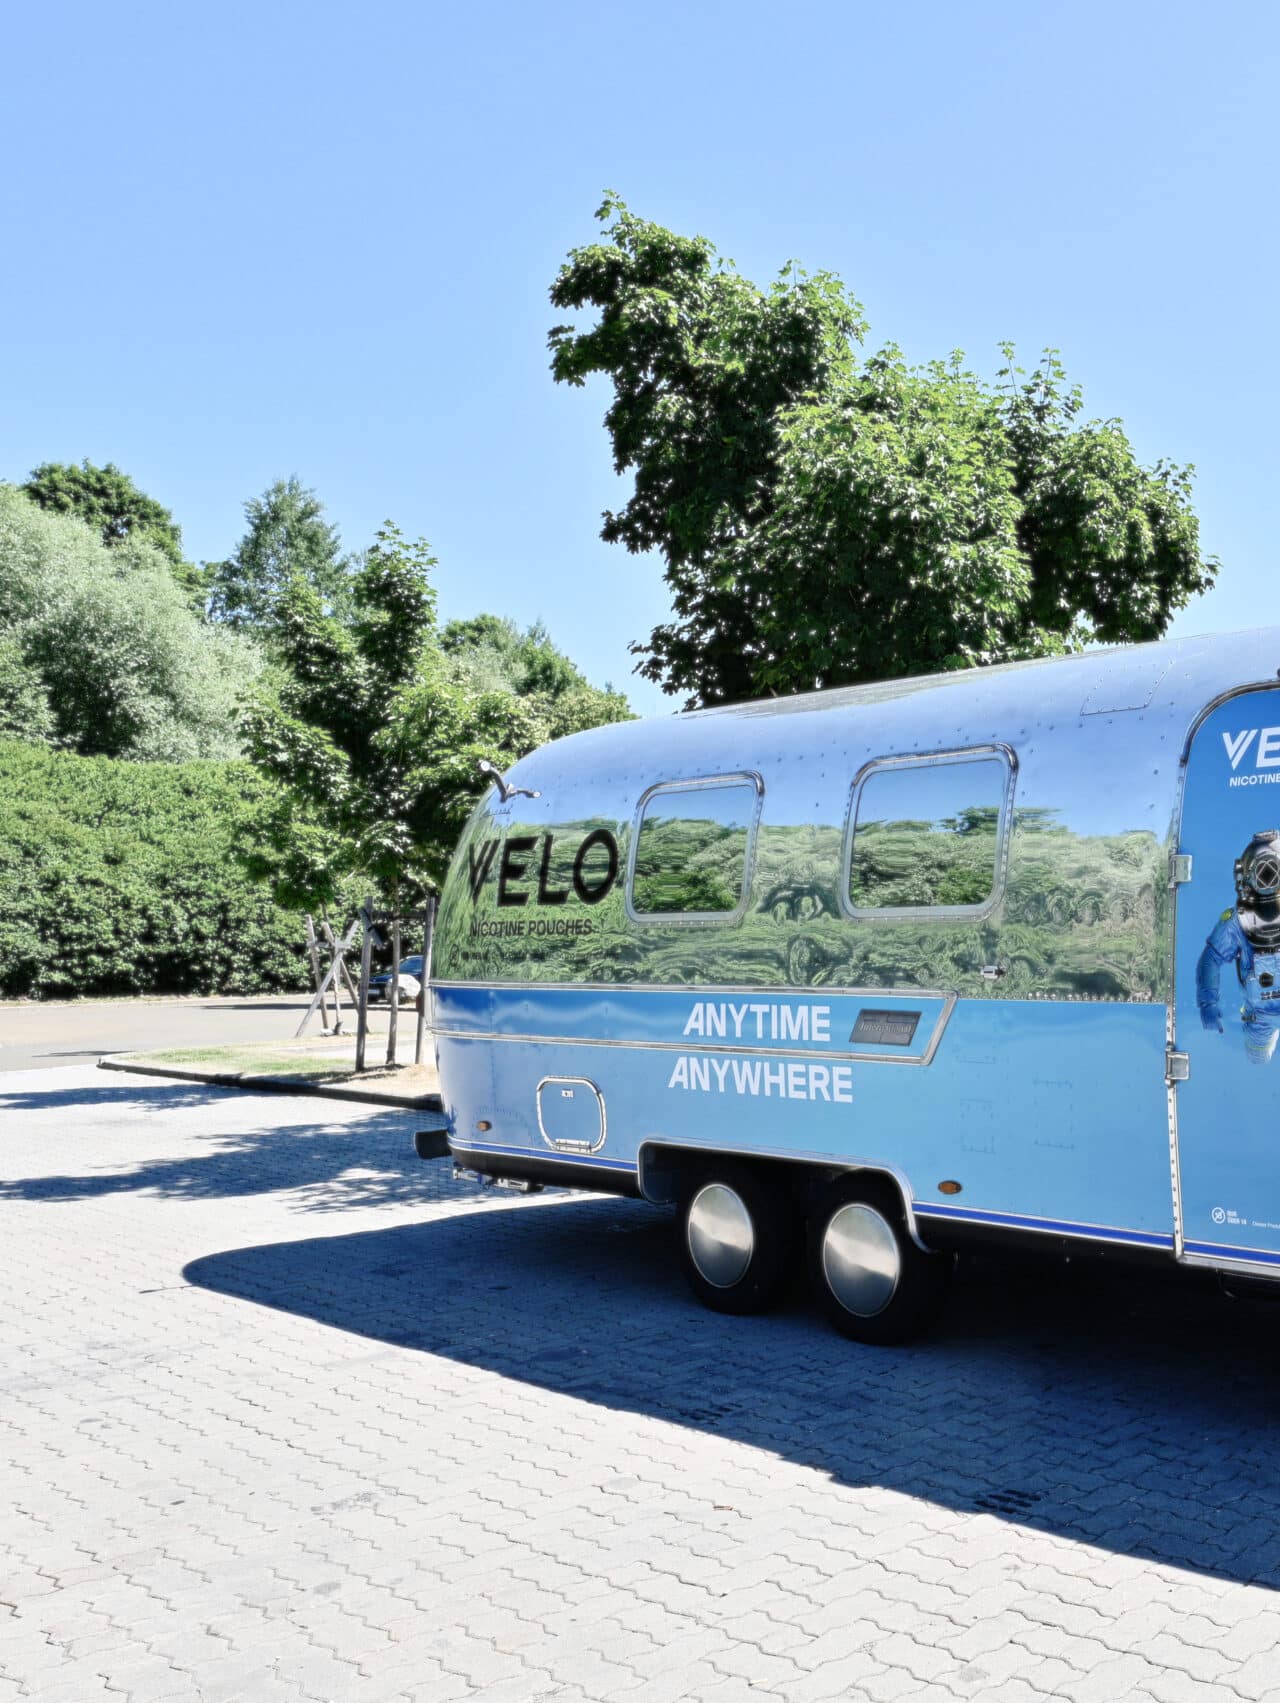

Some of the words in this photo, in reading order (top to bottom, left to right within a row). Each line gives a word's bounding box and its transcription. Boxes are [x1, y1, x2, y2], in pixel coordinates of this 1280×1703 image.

[469, 829, 618, 906] VELO
[470, 919, 525, 937] NICOTINE
[528, 919, 593, 936] POUCHES
[683, 1002, 831, 1042] ANYTIME
[668, 1056, 854, 1103] ANYWHERE
